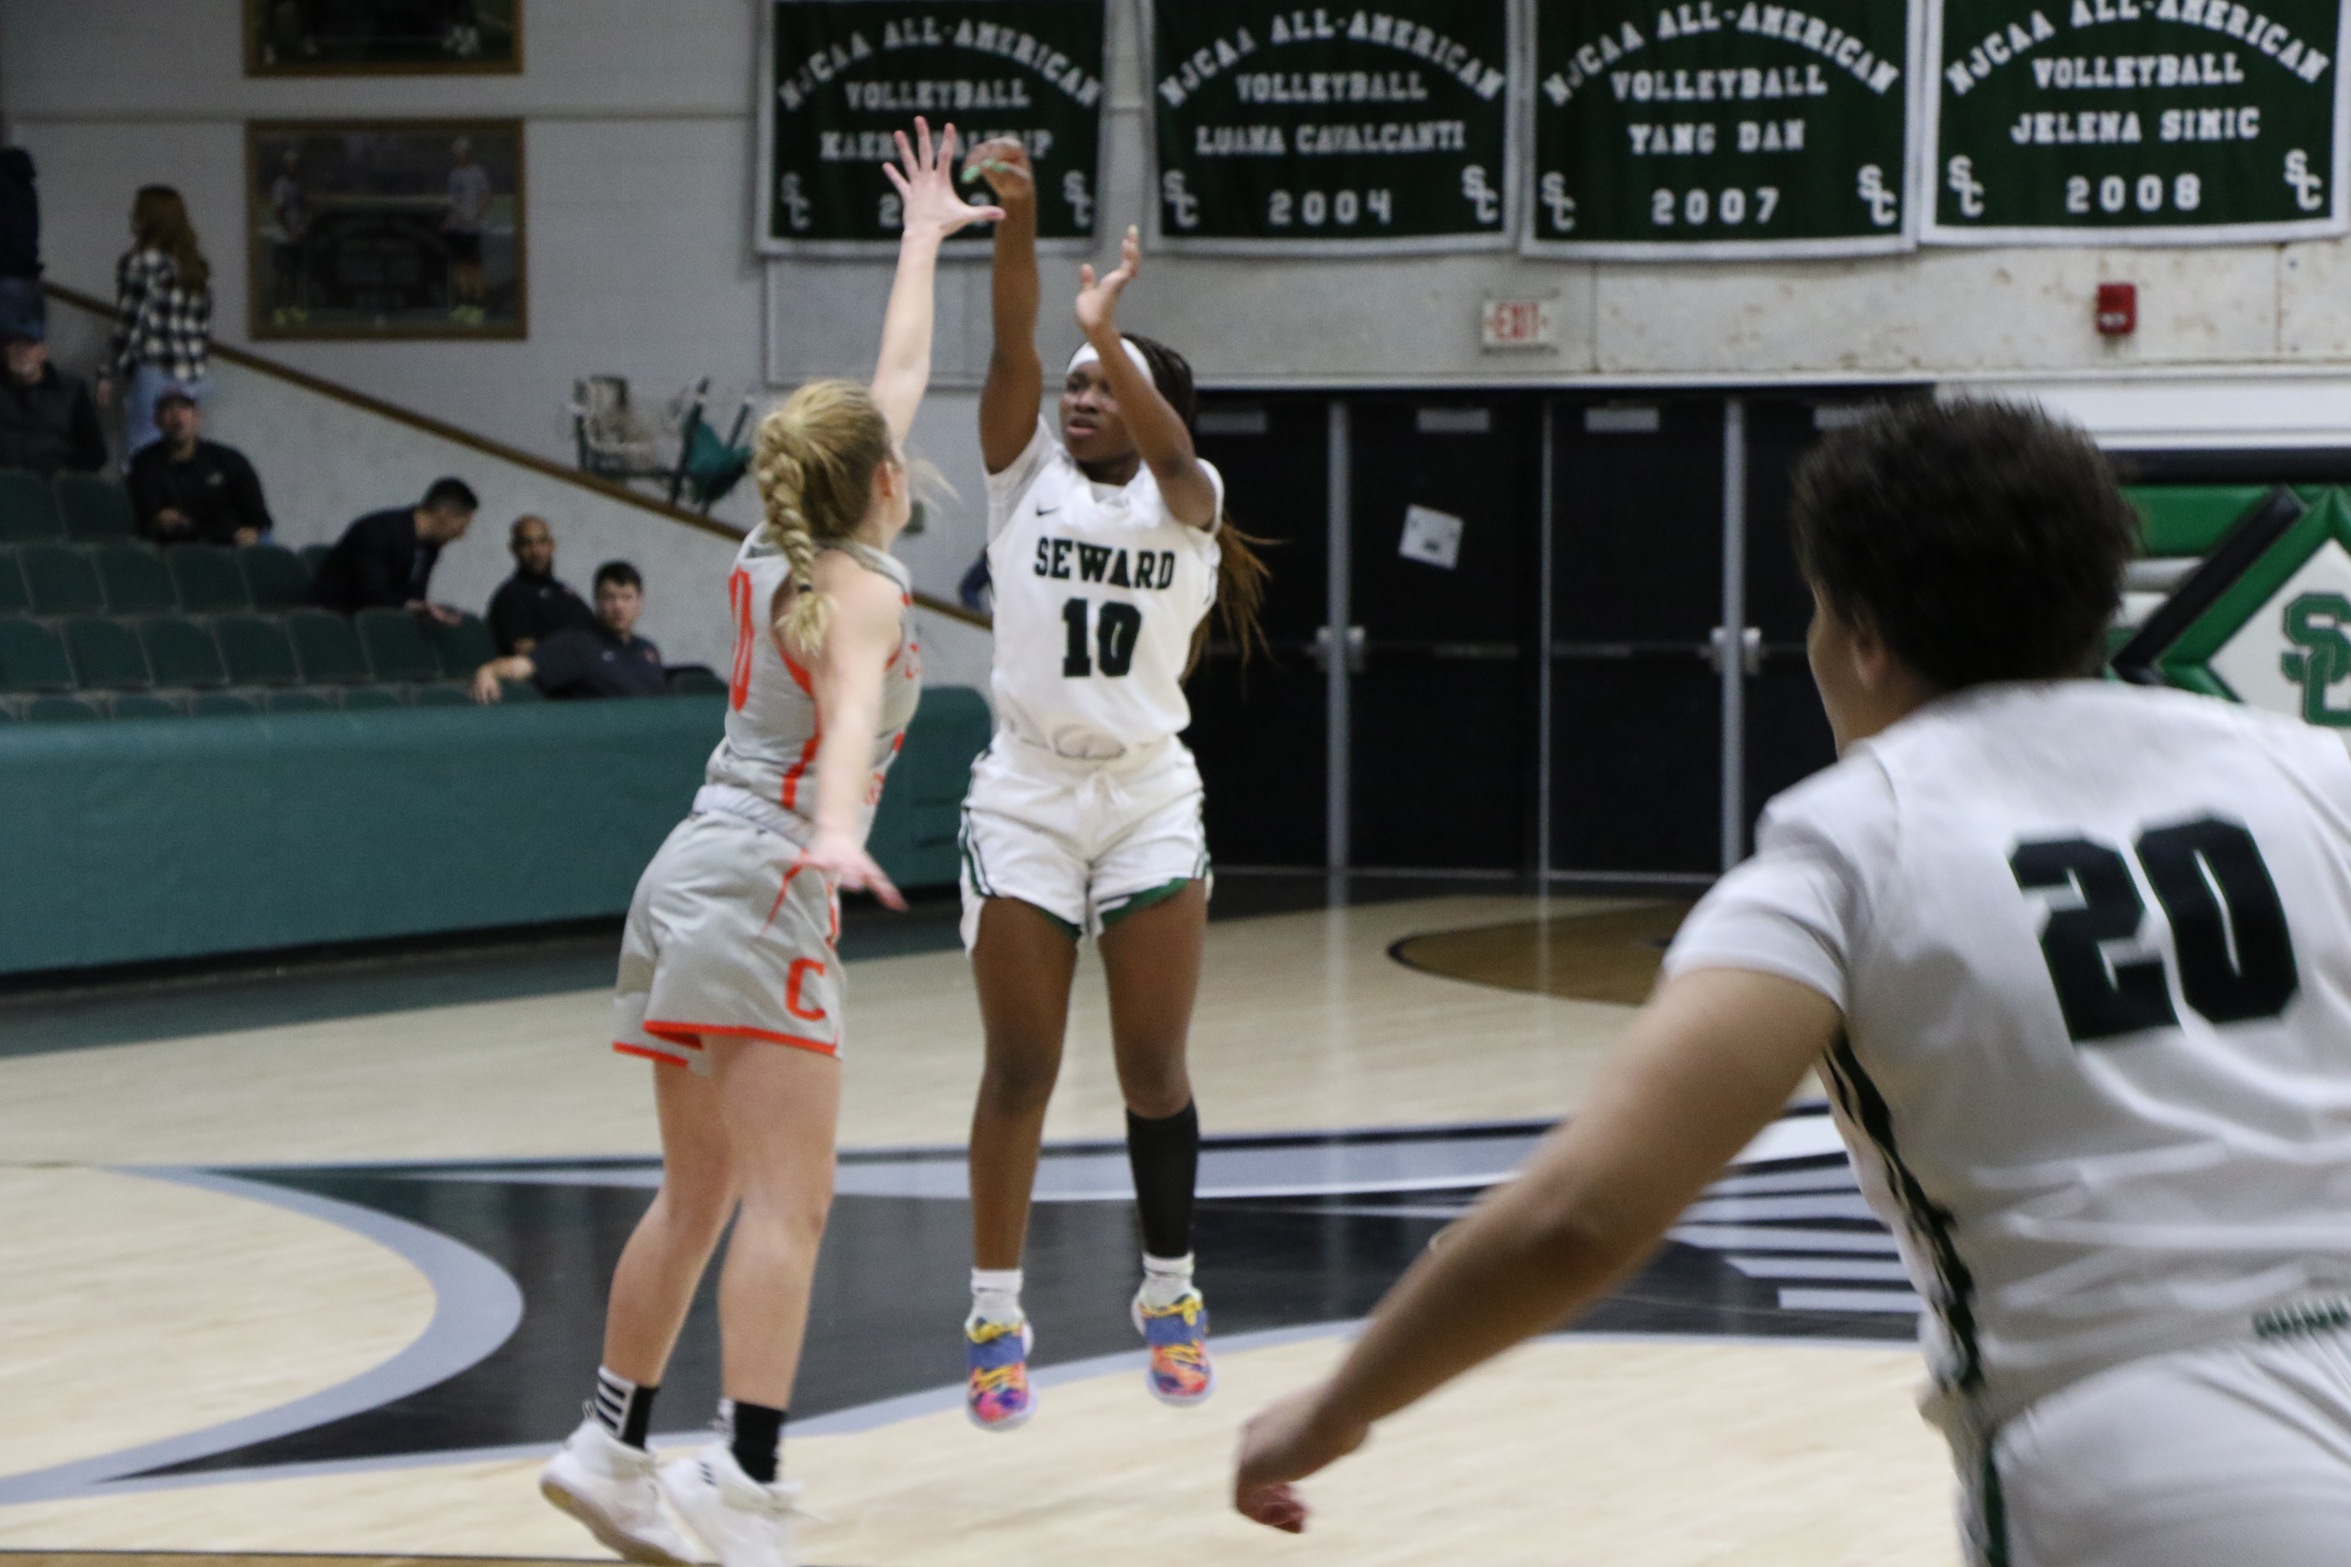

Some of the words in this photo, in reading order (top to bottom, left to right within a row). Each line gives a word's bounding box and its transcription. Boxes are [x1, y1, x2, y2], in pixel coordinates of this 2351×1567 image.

[779, 31, 872, 110] NJCAA
[884, 17, 1101, 106] ALL-AMERICAN
[1159, 26, 1257, 107] NJCAA
[1271, 9, 1503, 100] ALL-AMERICAN
[1543, 21, 1645, 106] NJCAA
[1658, 2, 1899, 94] ALL-AMERICAN
[1945, 10, 2055, 95] NJCAA
[2071, 0, 2330, 84] ALL-AMERICAN
[1236, 71, 1428, 102] VOLLEYBALL
[1611, 65, 1828, 101] VOLLEYBALL
[2033, 52, 2244, 88] VOLLEYBALL
[846, 79, 1030, 108] VOLLEYBALL
[1196, 125, 1286, 155] LUANA
[1296, 120, 1465, 153] CAVALCANTI
[1629, 123, 1716, 154] YANG
[1738, 119, 1805, 152] DAN
[2010, 112, 2142, 144] JELENA
[2160, 106, 2260, 141] SIMIC
[1268, 190, 1391, 226] 2004
[1652, 187, 1779, 224] 2007
[2067, 173, 2201, 212] 2008
[1494, 301, 1539, 340] EXIT
[1034, 536, 1175, 589] SEWARD
[1063, 598, 1142, 677] 10
[2009, 813, 2298, 1043] 20
[785, 958, 825, 1022] C
